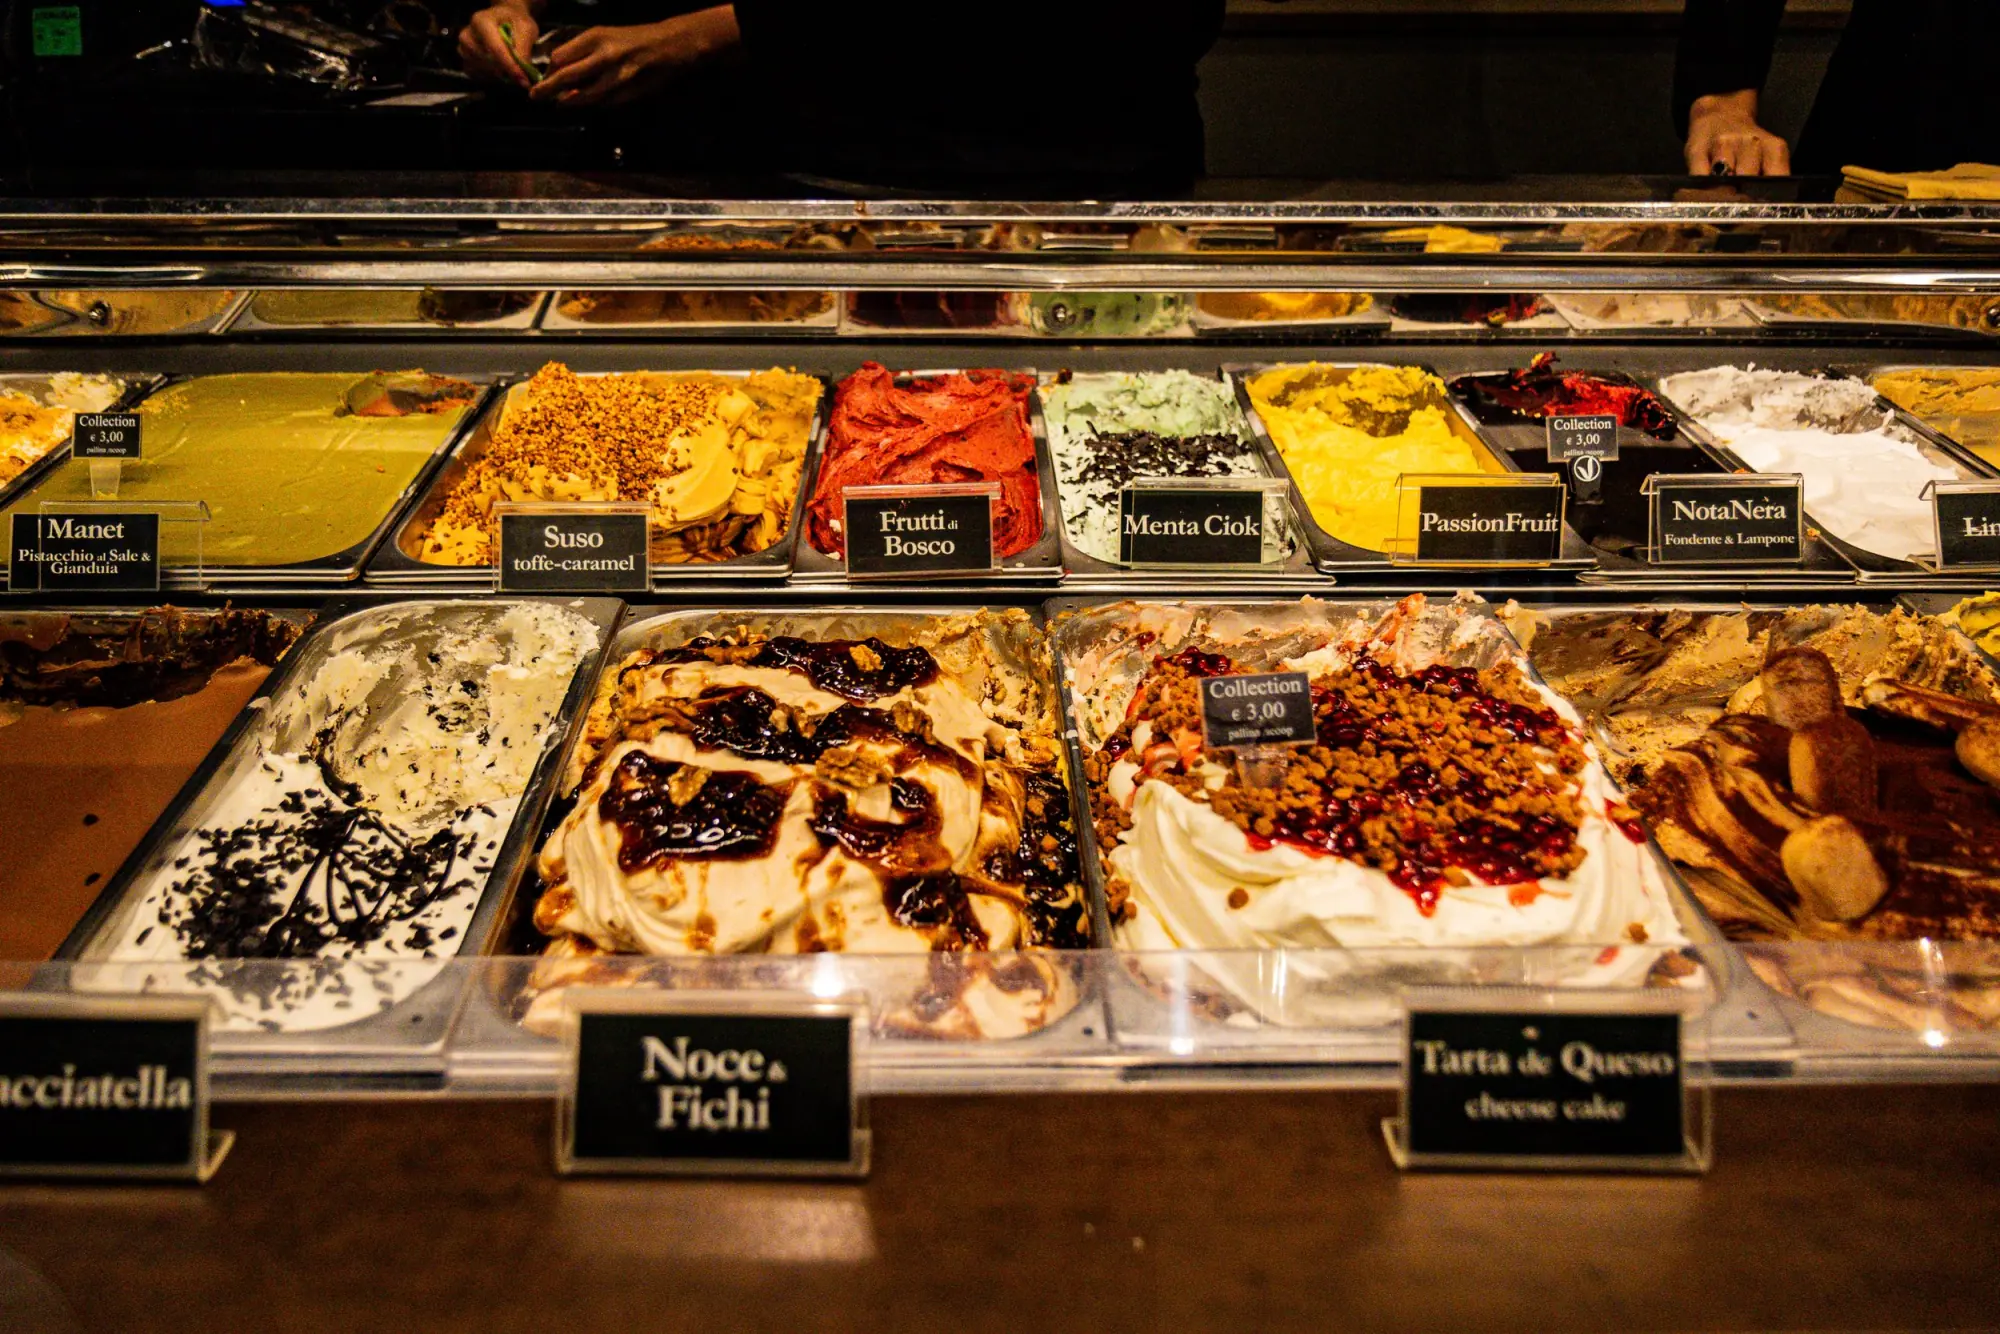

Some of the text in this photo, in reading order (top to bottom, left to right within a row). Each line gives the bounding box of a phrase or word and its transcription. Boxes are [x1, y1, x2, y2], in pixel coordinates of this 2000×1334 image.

[79, 415, 136, 427] Collection
[1553, 418, 1612, 431] Collection
[90, 431, 124, 444] € 3,00
[1575, 433, 1601, 447] 3,00
[879, 509, 958, 532] Frutti di
[1672, 500, 1787, 520] NotaNera
[47, 518, 125, 539] Manet
[1124, 514, 1260, 536] Menta Ciok
[1422, 512, 1559, 532] PassionFruit
[544, 525, 604, 548] Suso
[884, 535, 956, 557] Bosco
[1664, 533, 1795, 547] Fondente & Lampone
[18, 549, 151, 562] Pistacchio al Sale &
[513, 555, 635, 571] toffe-caramel
[51, 562, 119, 575] Gianduia
[1209, 676, 1303, 699] Collection
[1246, 701, 1286, 722] 3,00
[641, 1036, 765, 1082] Noce
[1415, 1040, 1510, 1075] Tarta
[1559, 1041, 1675, 1084] Queso
[656, 1085, 771, 1131] Fichi
[1562, 1094, 1625, 1121] cake
